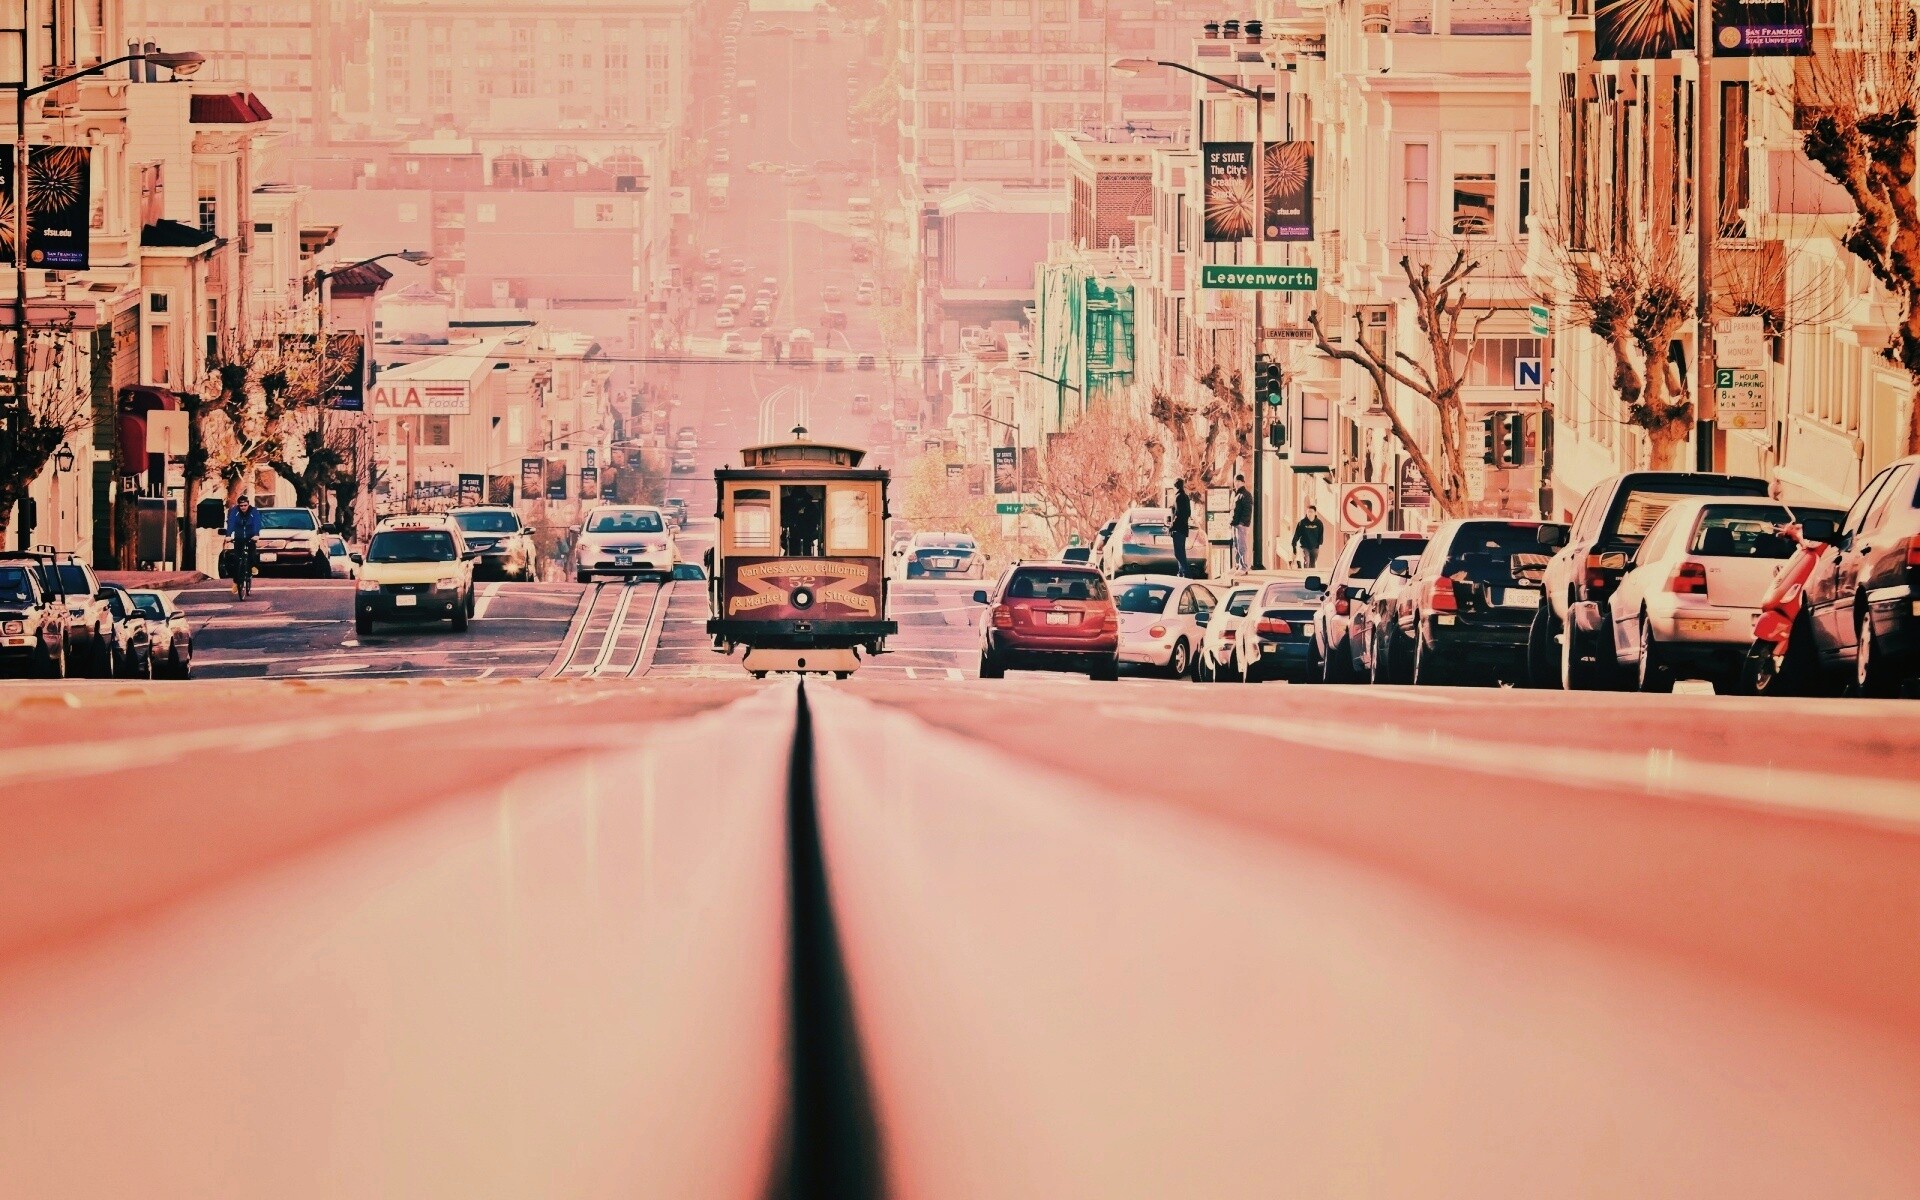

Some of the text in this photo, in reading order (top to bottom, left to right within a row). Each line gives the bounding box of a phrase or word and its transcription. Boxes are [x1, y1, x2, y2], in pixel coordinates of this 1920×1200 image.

[1761, 28, 1803, 36] FRANCISCO
[1210, 153, 1245, 163] SF STATE
[1210, 164, 1248, 176] The City's
[43, 227, 72, 237] sfsu.edu
[1206, 270, 1313, 286] Leavenworth
[1266, 330, 1312, 338] LEAVENWORTH
[1727, 348, 1754, 356] MONDAY
[1519, 361, 1541, 385] N
[1720, 372, 1731, 385] 2
[1734, 381, 1764, 389] PARKING
[428, 397, 465, 408] Foods
[739, 566, 757, 578] Van
[759, 563, 785, 574] Ness
[814, 562, 867, 577] California
[789, 576, 816, 588] 52
[734, 589, 869, 608] & Market Streets
